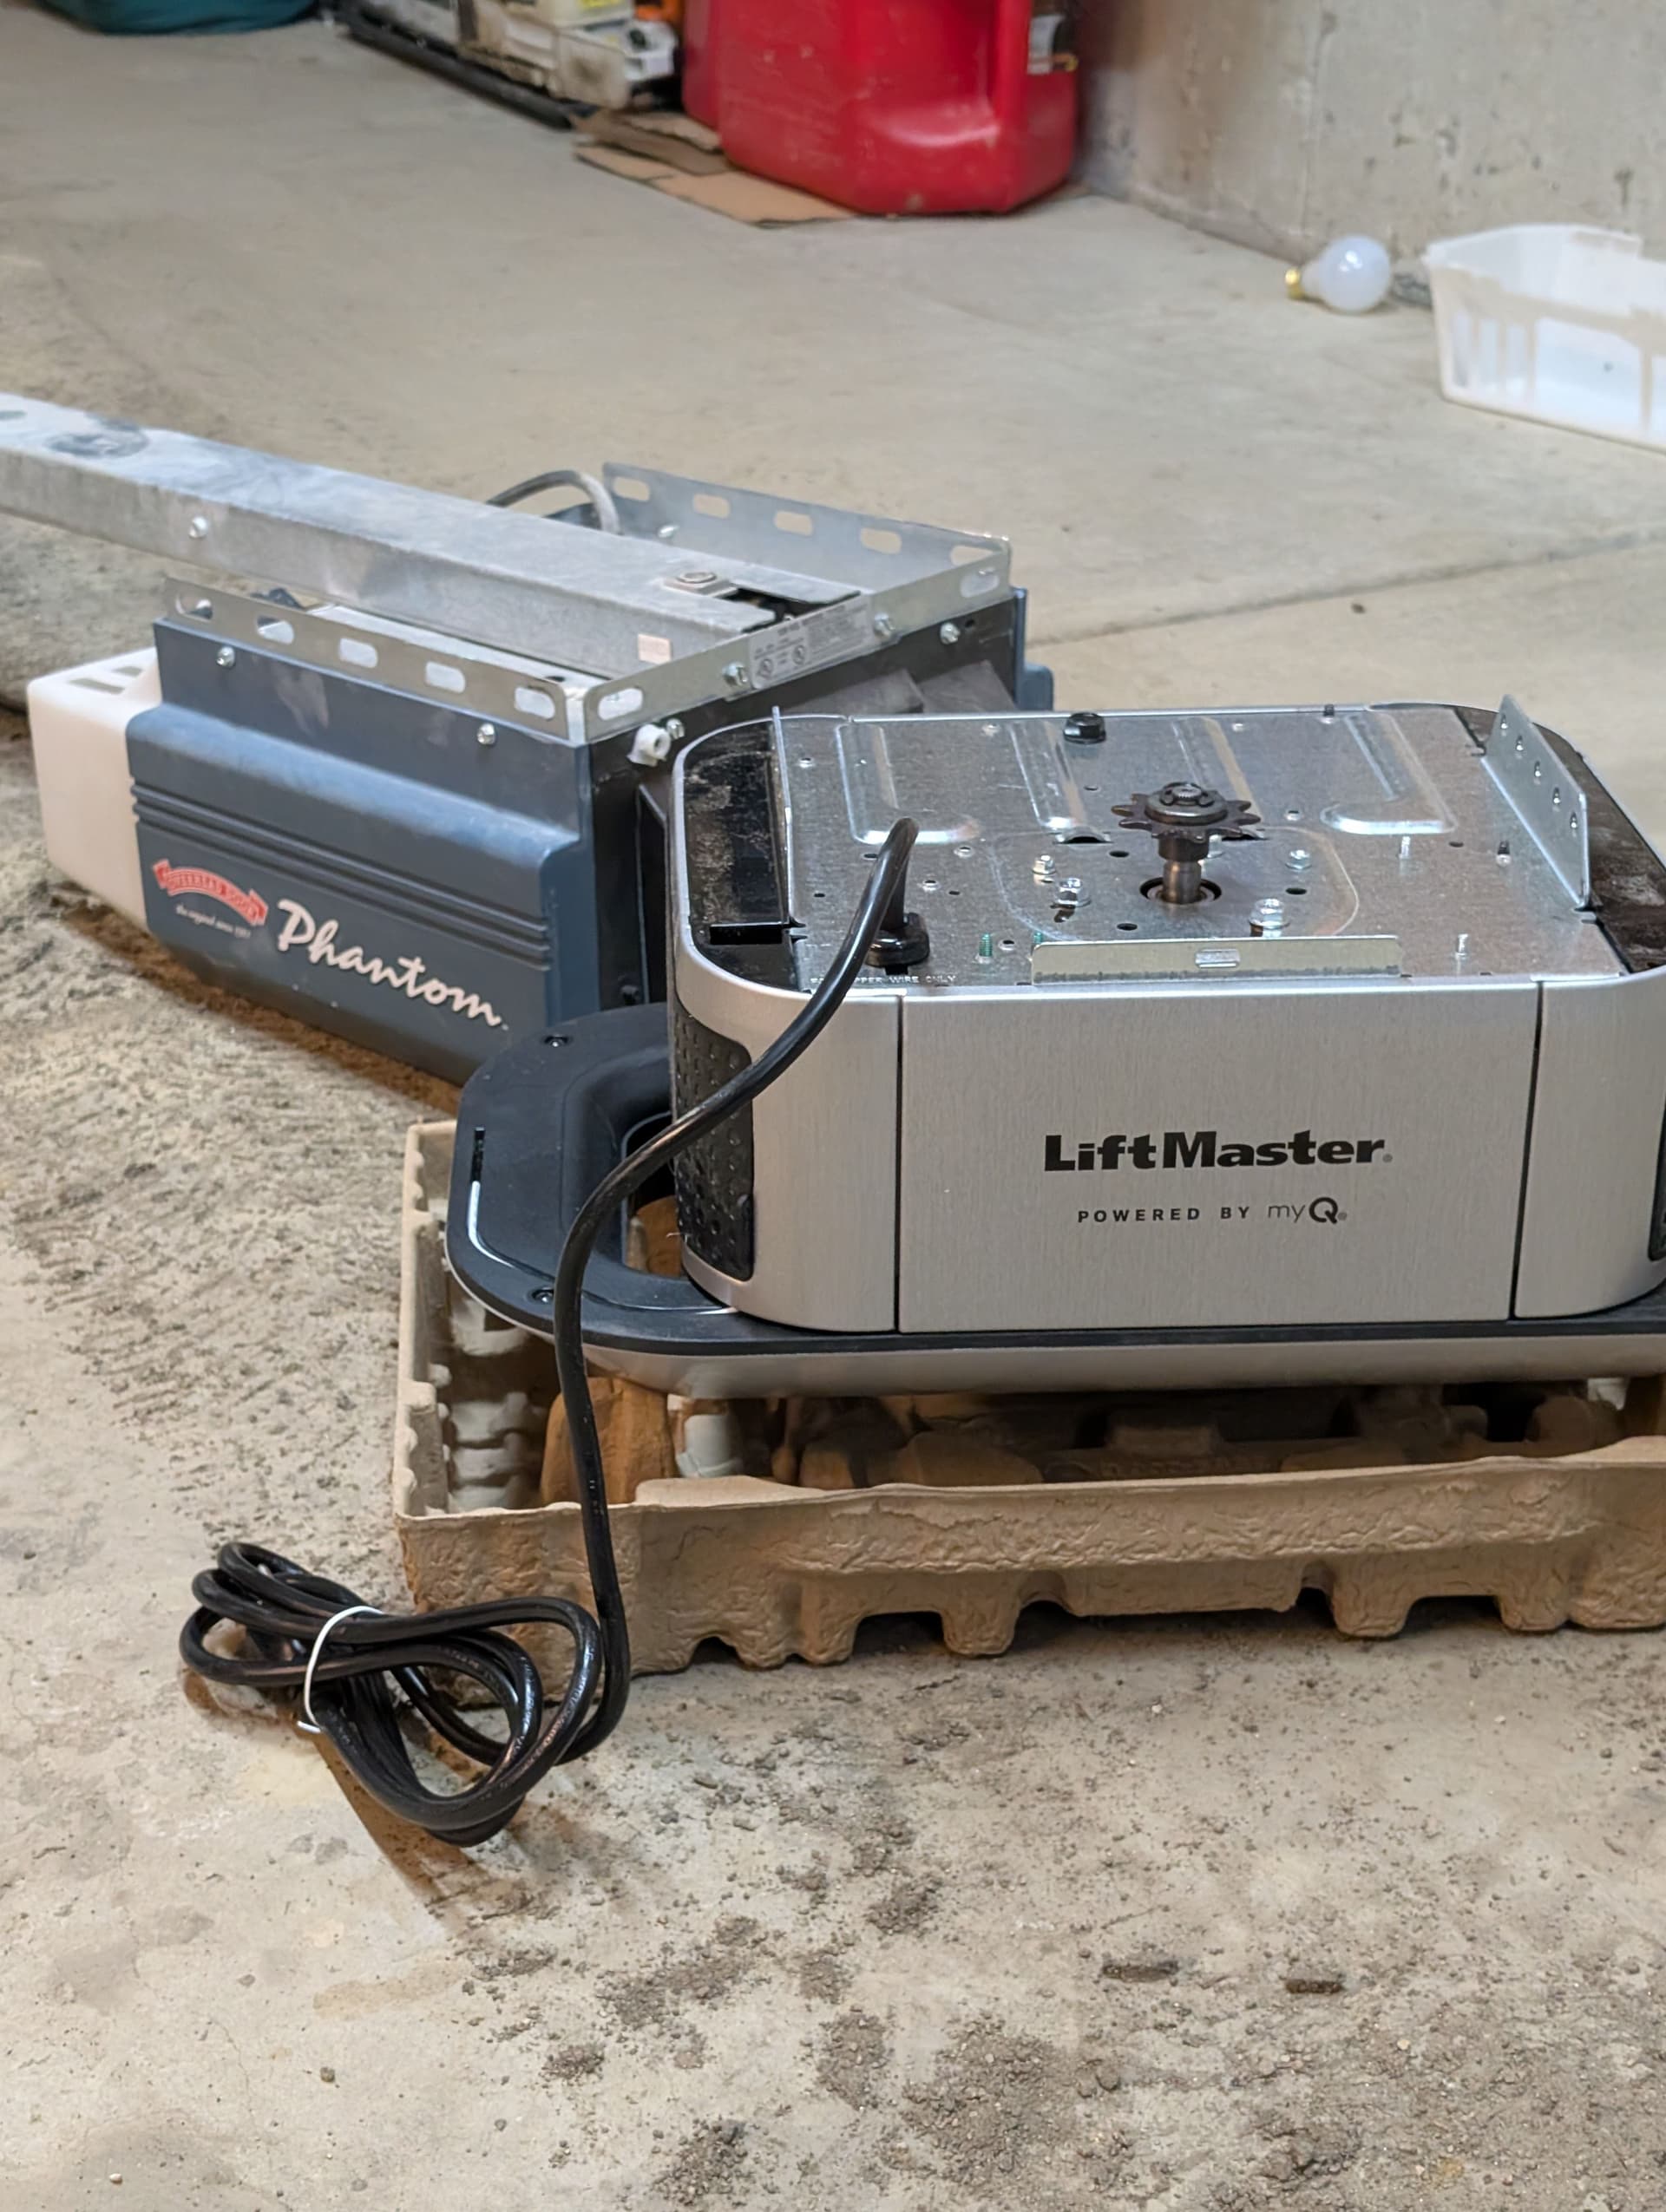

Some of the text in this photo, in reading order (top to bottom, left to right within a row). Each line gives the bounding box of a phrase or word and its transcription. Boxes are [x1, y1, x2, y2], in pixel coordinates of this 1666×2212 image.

[279, 899, 502, 1027] Phantom
[889, 975, 920, 984] WIRE
[1045, 1129, 1385, 1171] LiftMaster
[1078, 1196, 1338, 1224] POWERED BY myQ
